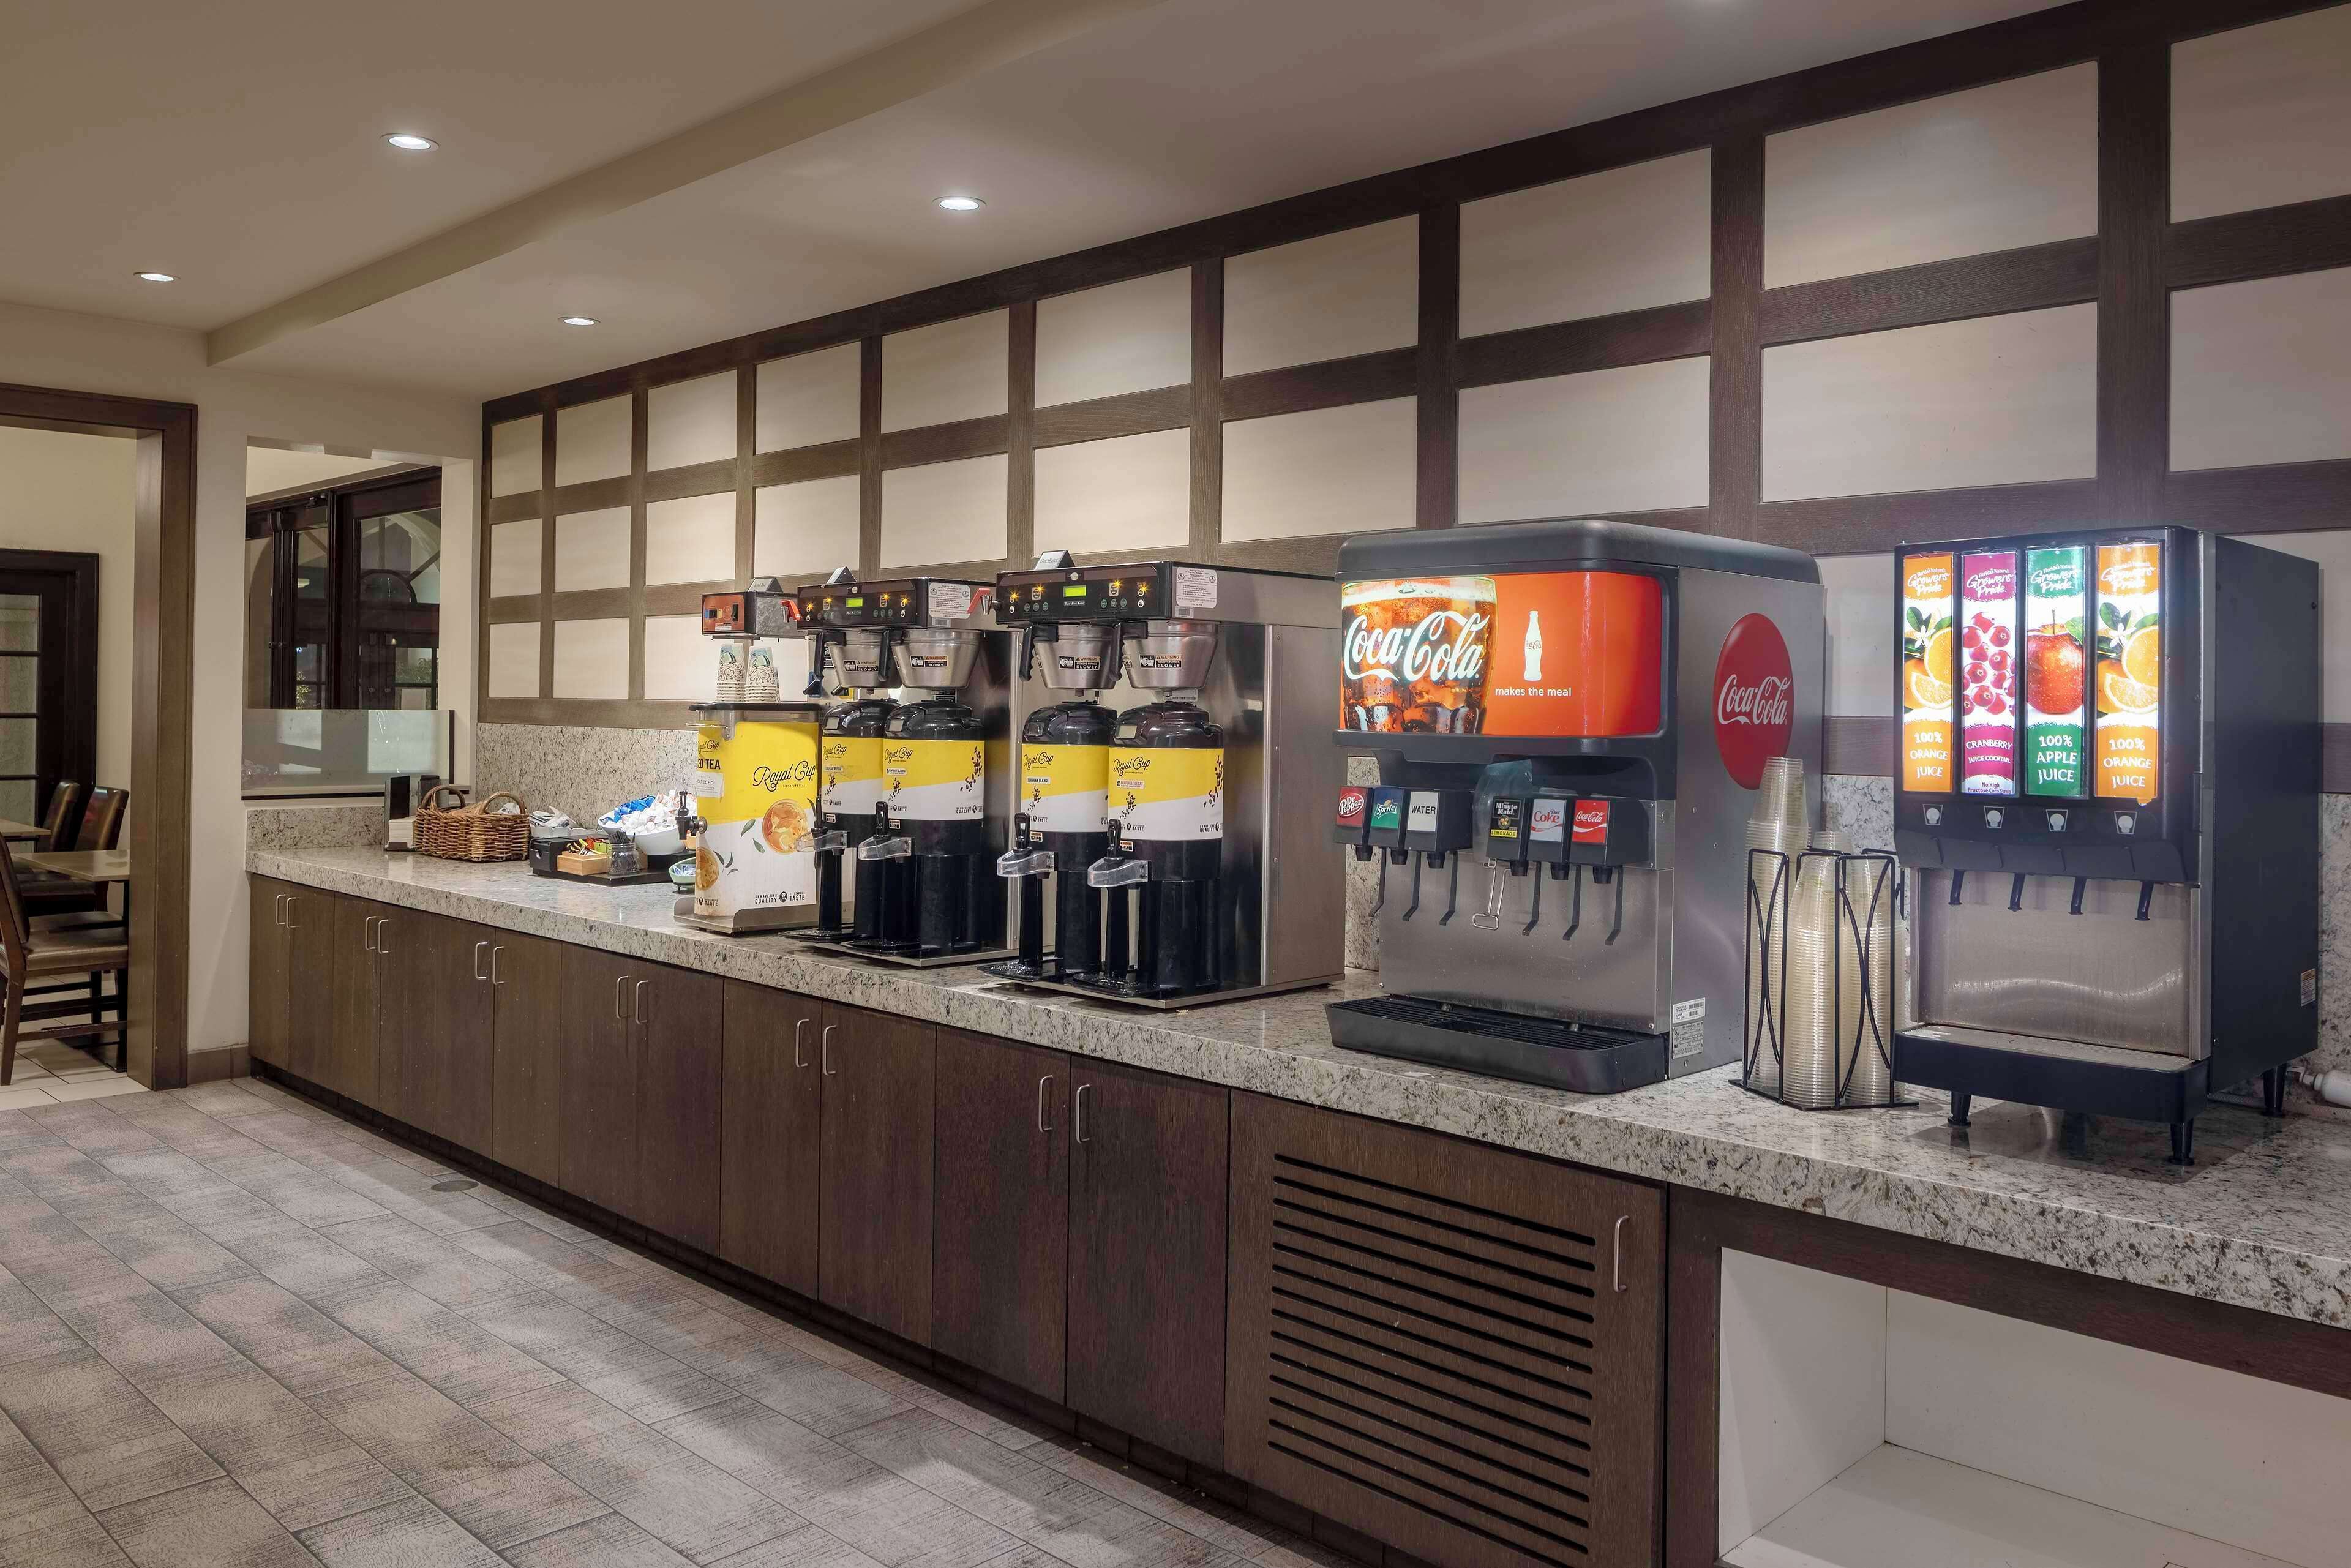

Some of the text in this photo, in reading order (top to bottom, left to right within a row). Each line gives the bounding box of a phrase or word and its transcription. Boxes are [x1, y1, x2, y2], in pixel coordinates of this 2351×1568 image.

[1344, 611, 1490, 683] Coca-Cola
[1495, 686, 1572, 696] makes the meal
[1717, 673, 1791, 726] Coca-Cola
[1914, 731, 1943, 744] 100%
[2038, 734, 2073, 748] 100%
[2109, 737, 2145, 751] 100%
[707, 739, 720, 751] Cup
[1965, 738, 2012, 751] CRANBERRY
[823, 743, 847, 760] Royal Cup
[885, 746, 913, 764] Royal Cup
[1910, 749, 1948, 760] ORANGE
[2036, 751, 2077, 765] APPLE
[705, 759, 721, 770] TEA
[1023, 751, 1054, 771] Royal Cup
[1113, 756, 1151, 776] Royal Cup
[1968, 756, 2011, 764] JUICE COCKTAIL
[2103, 757, 2153, 769] ORANGE
[752, 760, 816, 792] Royal Cup
[1916, 766, 1943, 779] JUICE
[2038, 768, 2075, 784] JUICE
[2112, 775, 2145, 789] JUICE
[1339, 798, 1362, 815] Pepper
[1346, 796, 1355, 805] Dr
[1376, 804, 1395, 816] Sprite
[1411, 805, 1436, 814] WATER
[1534, 811, 1559, 823] Coke
[1575, 811, 1605, 823] Coca-Cola
